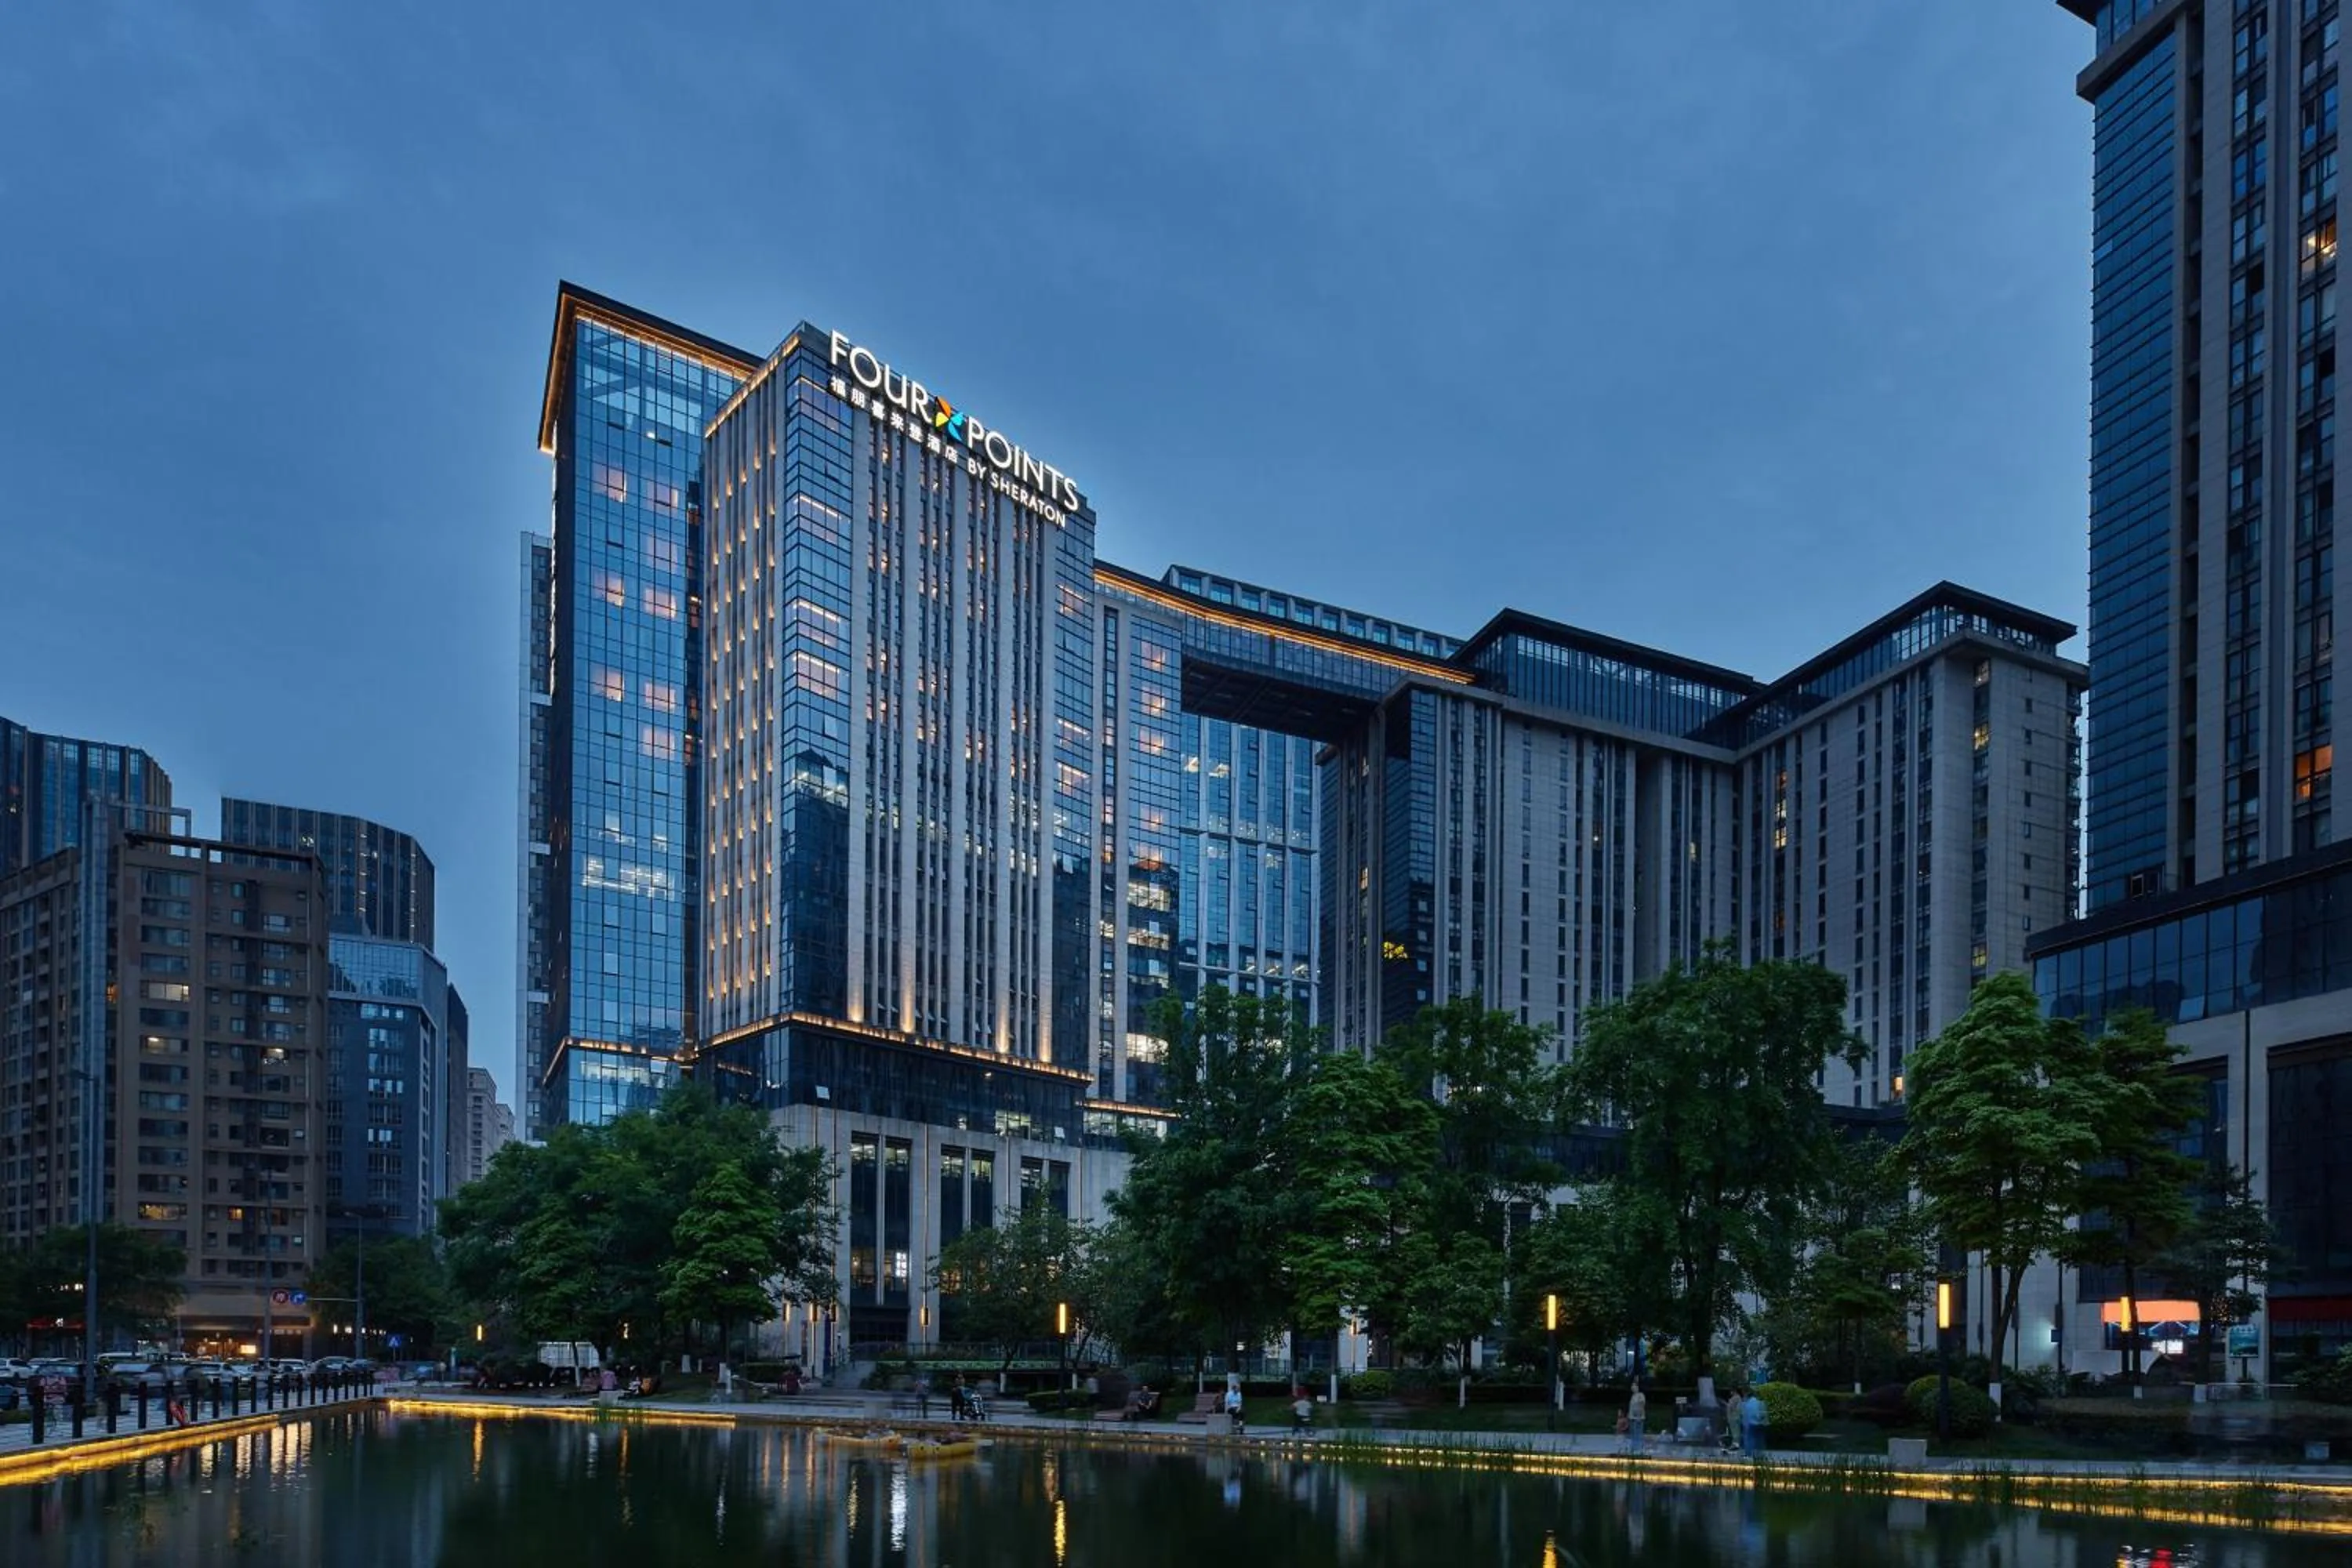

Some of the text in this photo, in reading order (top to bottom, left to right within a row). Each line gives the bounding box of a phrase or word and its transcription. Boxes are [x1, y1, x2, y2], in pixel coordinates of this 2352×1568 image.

[831, 330, 1079, 510] FOUR POINTS
[967, 458, 1065, 528] BY SHERATON
